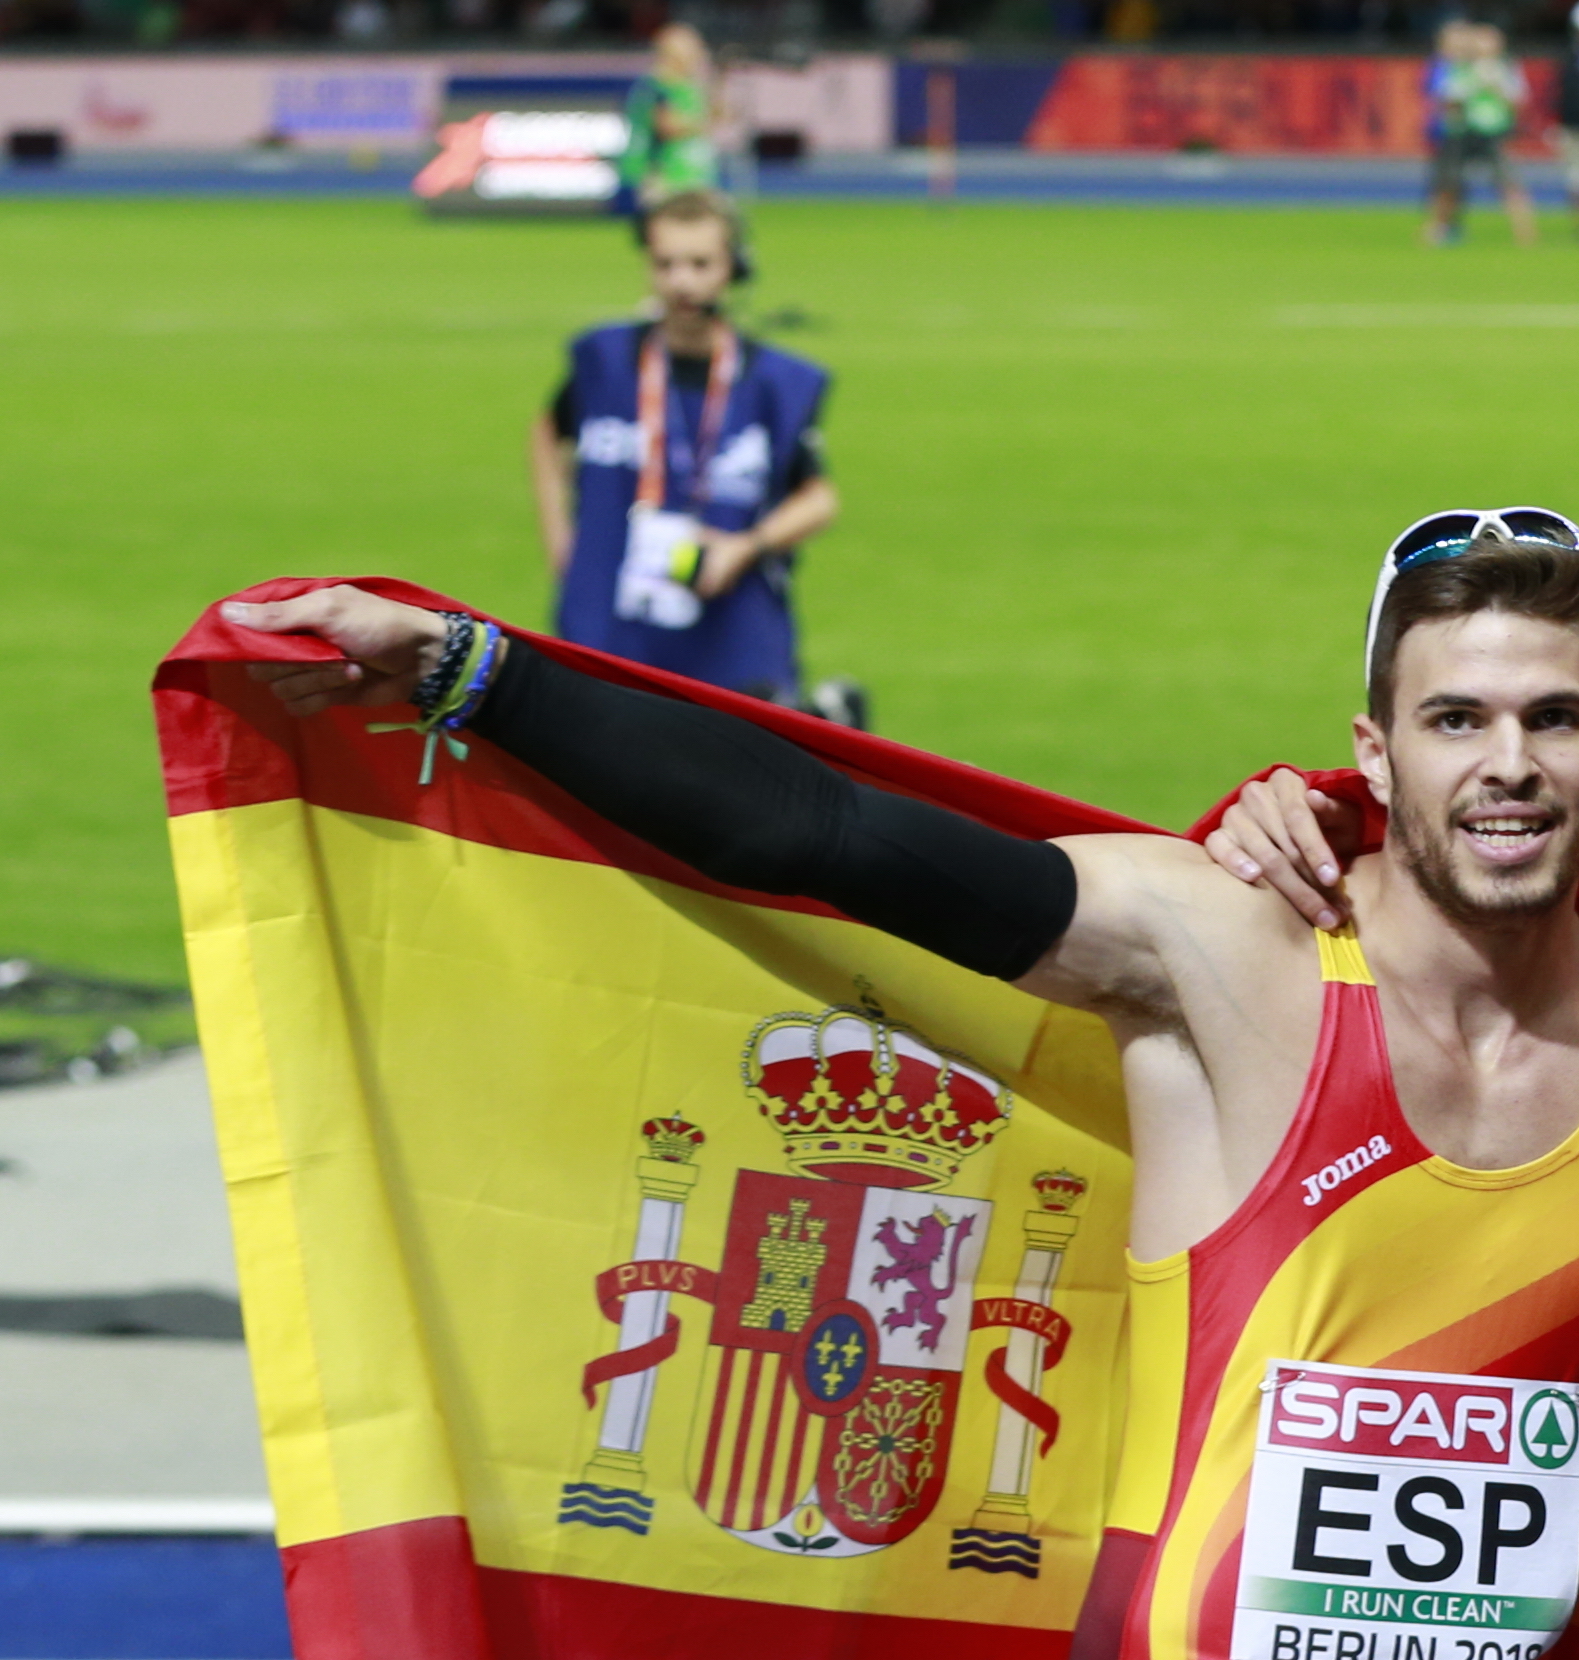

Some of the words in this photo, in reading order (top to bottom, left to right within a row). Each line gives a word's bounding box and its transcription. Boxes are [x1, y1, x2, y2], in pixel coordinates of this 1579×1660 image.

[616, 1263, 698, 1292] PLVS
[982, 1301, 1061, 1341] VLTRA
[1277, 1381, 1507, 1453] SPAR
[1292, 1467, 1547, 1586] ESP
[1323, 1587, 1333, 1613] I
[1341, 1589, 1405, 1618] RUN
